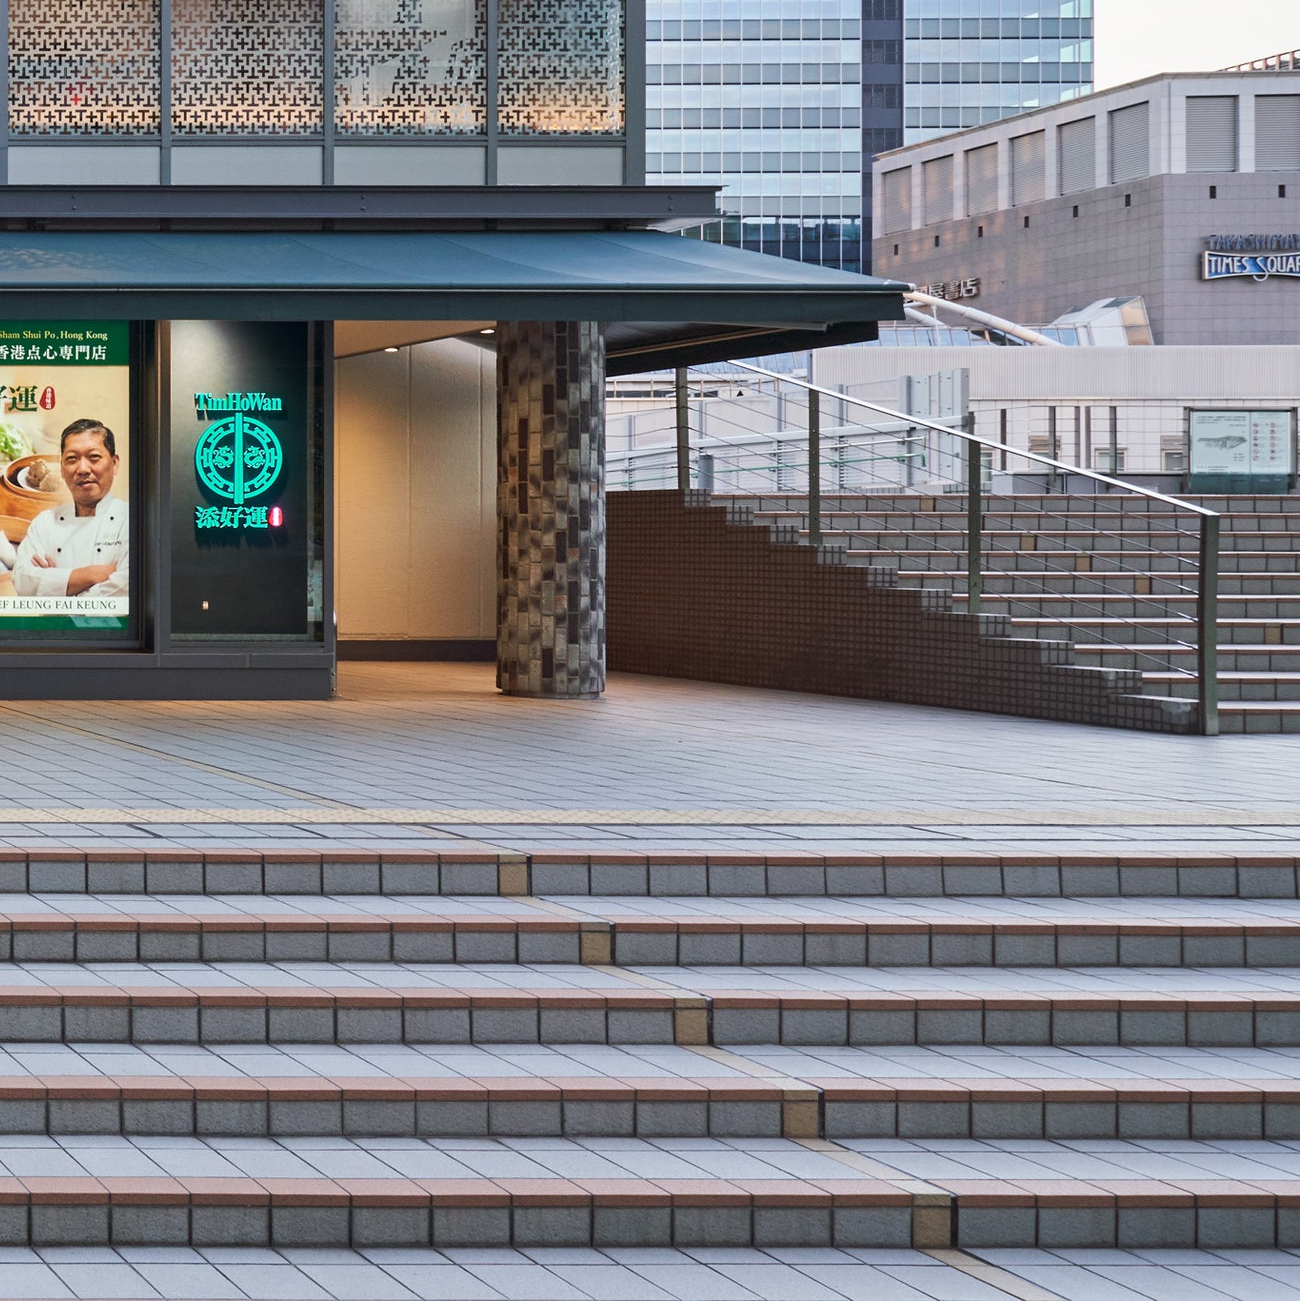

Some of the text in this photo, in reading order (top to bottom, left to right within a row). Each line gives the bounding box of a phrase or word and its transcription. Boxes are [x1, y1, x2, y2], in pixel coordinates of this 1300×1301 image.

[1208, 256, 1250, 273] TIMES
[22, 330, 41, 339] Shui
[60, 330, 83, 341] Hong
[86, 330, 108, 341] Kong
[195, 506, 269, 529] 添好運
[13, 600, 51, 610] LEUNG
[55, 600, 73, 610] FAI
[76, 600, 117, 610] KEUNG
